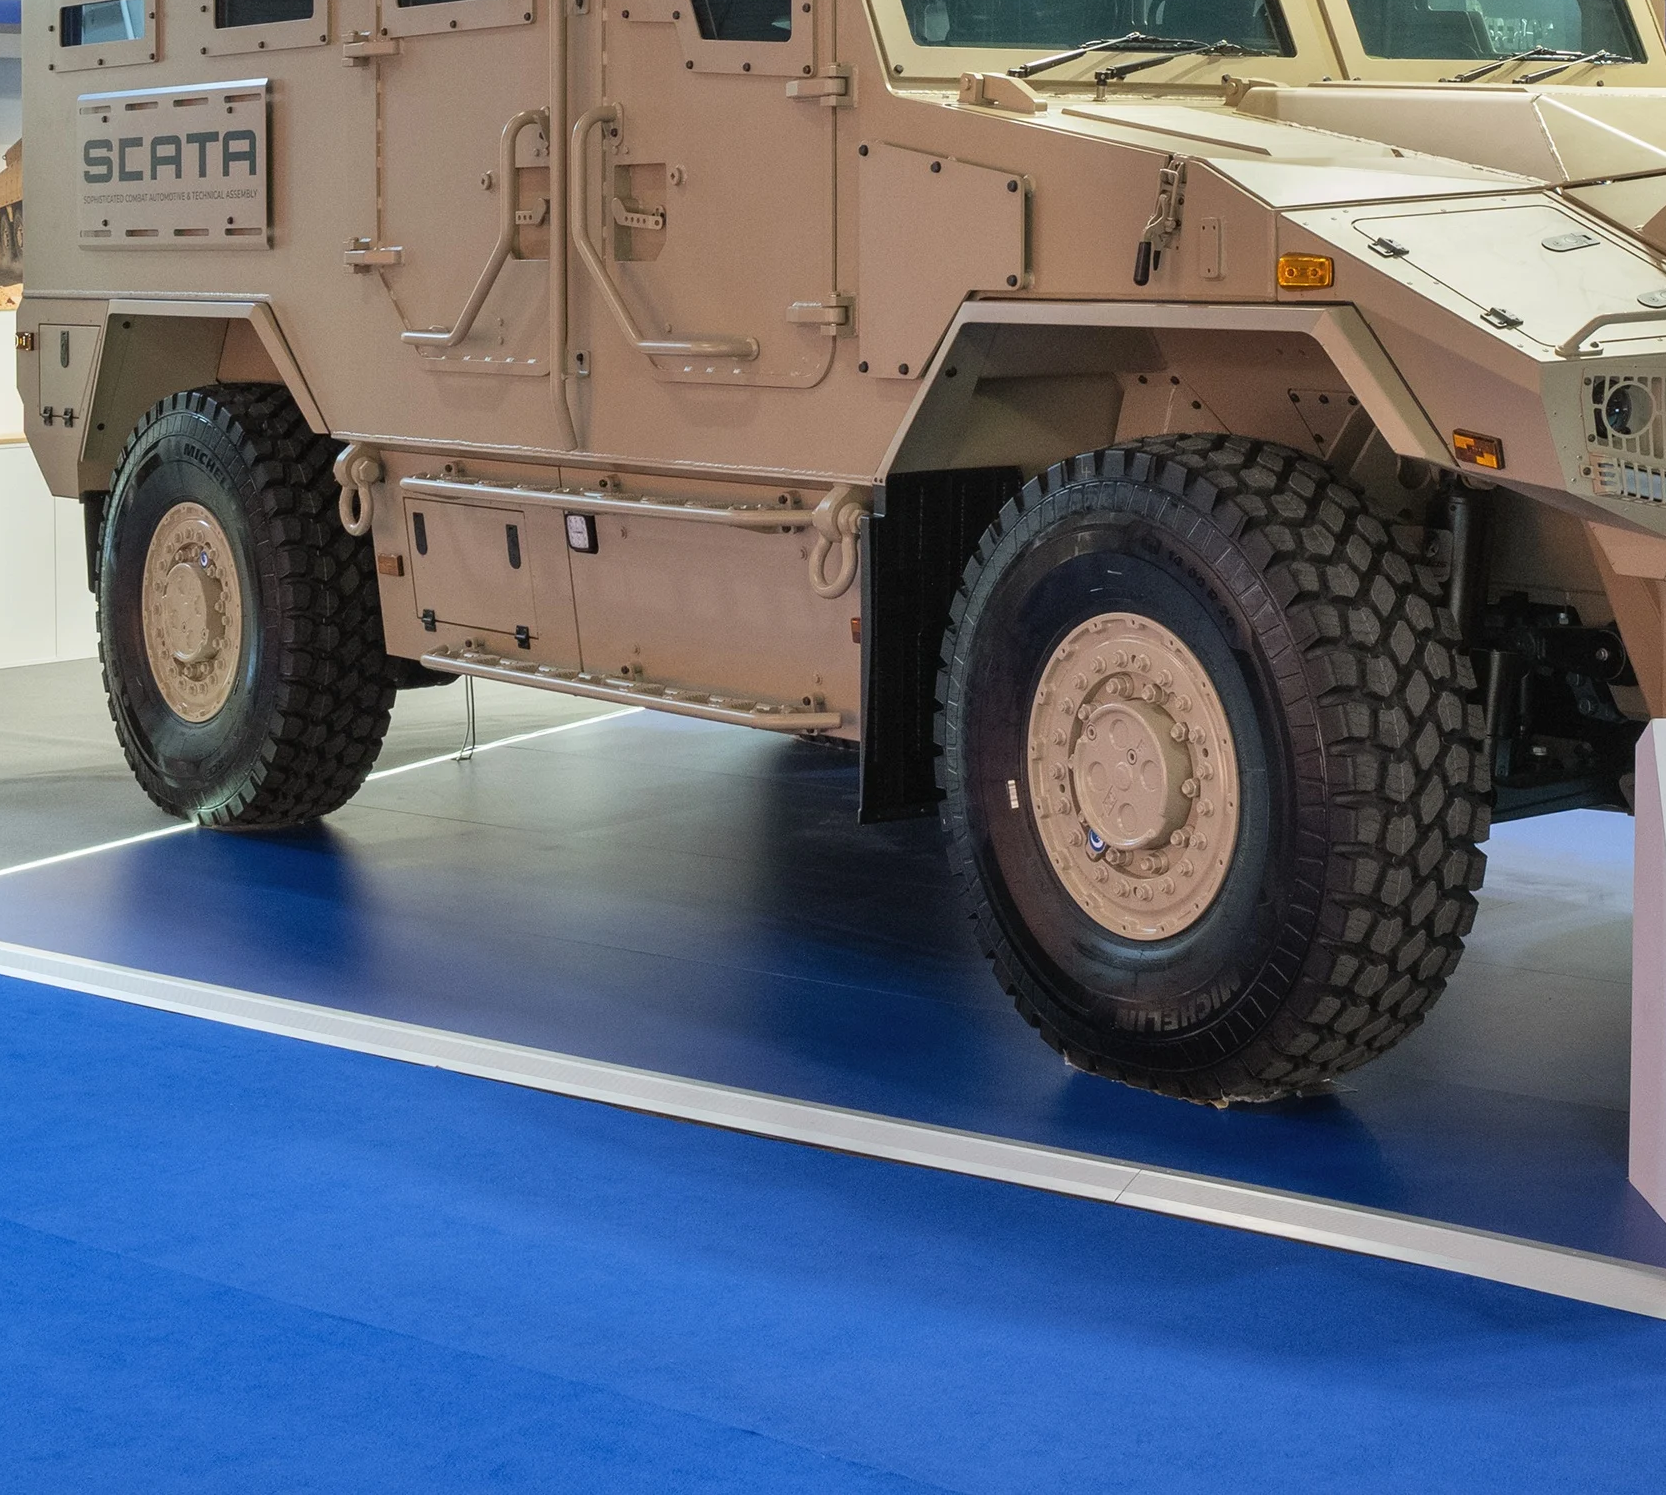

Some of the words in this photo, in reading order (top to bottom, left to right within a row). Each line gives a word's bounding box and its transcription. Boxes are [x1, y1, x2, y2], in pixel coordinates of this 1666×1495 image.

[83, 129, 257, 184] SCATA
[83, 193, 124, 205] SOPHISTICATED
[125, 192, 148, 203] COMBAT
[149, 191, 185, 202] AUTOMOTIVE
[186, 191, 191, 200] &
[192, 190, 224, 201] TECHNICAL
[225, 189, 258, 199] ASSEMBLY
[183, 442, 227, 489] MICHEL
[1115, 971, 1242, 1033] MICHELIN
